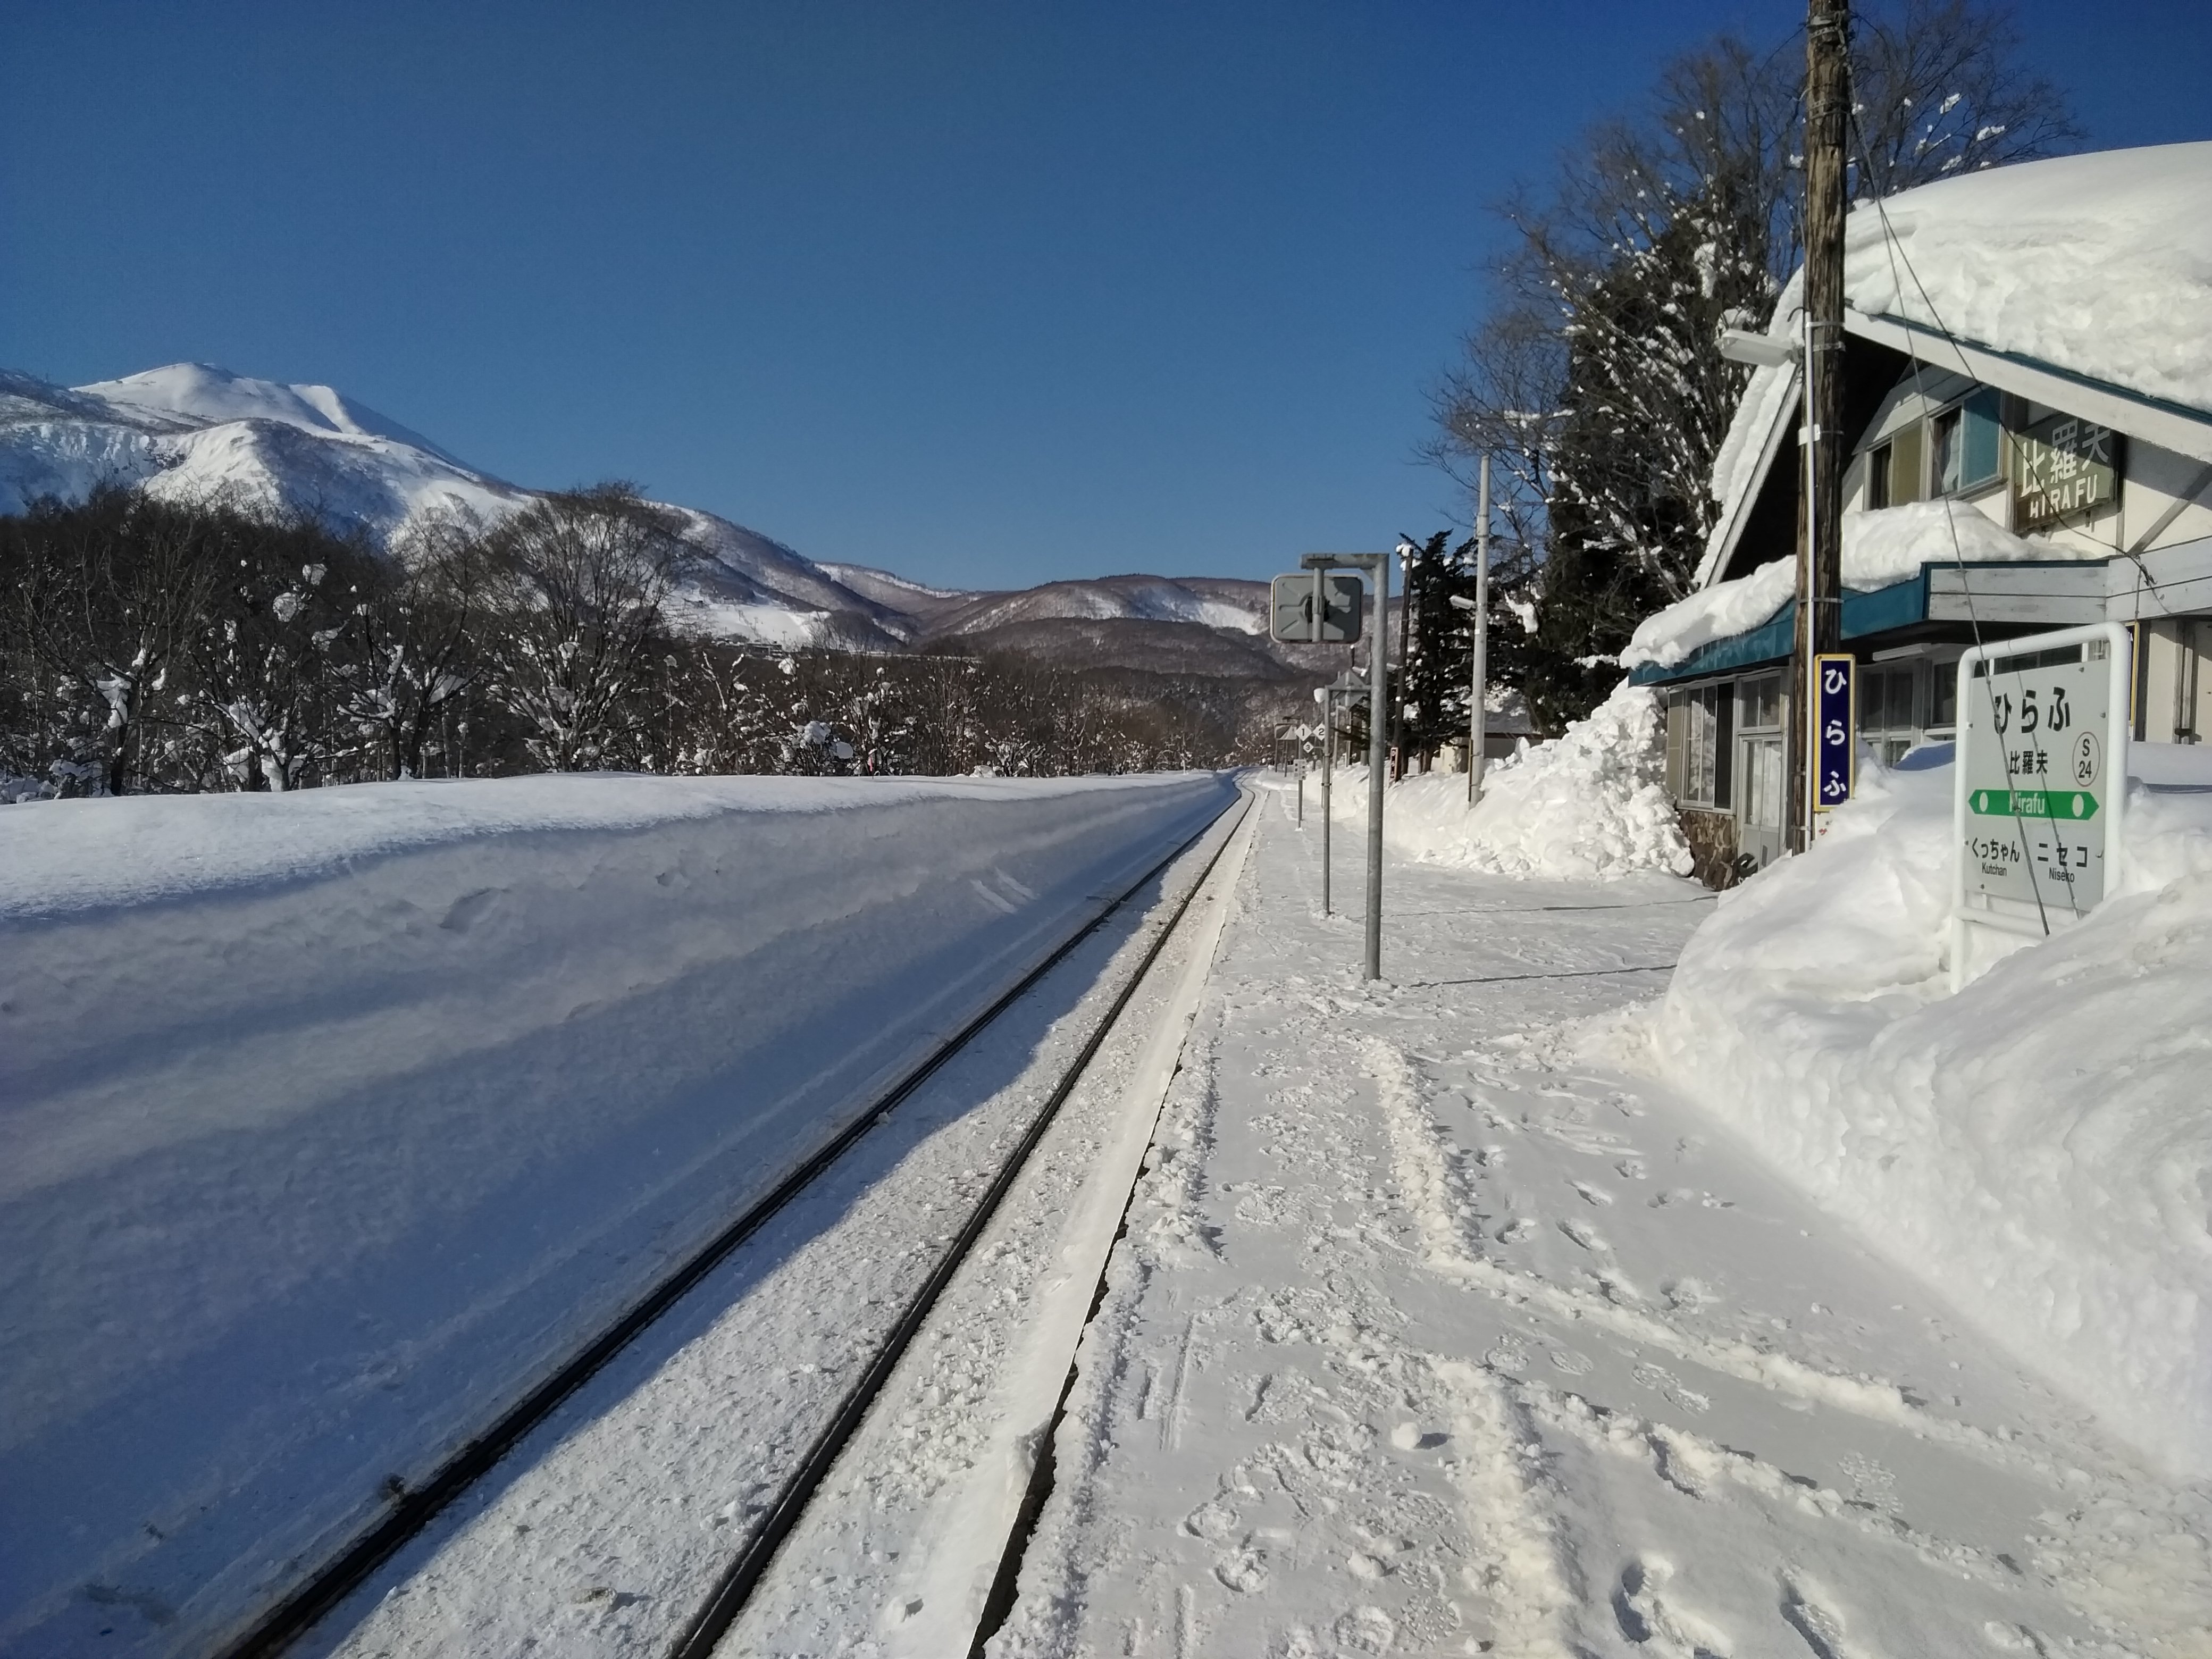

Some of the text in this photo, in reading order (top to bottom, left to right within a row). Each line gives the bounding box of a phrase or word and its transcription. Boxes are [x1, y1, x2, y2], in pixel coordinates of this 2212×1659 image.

[2030, 474, 2098, 518] HIRAFU
[1993, 686, 2071, 734] ひらふ
[1823, 669, 1847, 797] ひらふ
[2082, 738, 2090, 757] S
[2009, 749, 2048, 775] 比羅夫
[2079, 760, 2092, 778] 24
[1972, 837, 2020, 862] くっちゃん
[2037, 842, 2088, 868] ニセコ
[1982, 862, 2007, 876] Kutchan
[2049, 867, 2075, 883] Niseko
